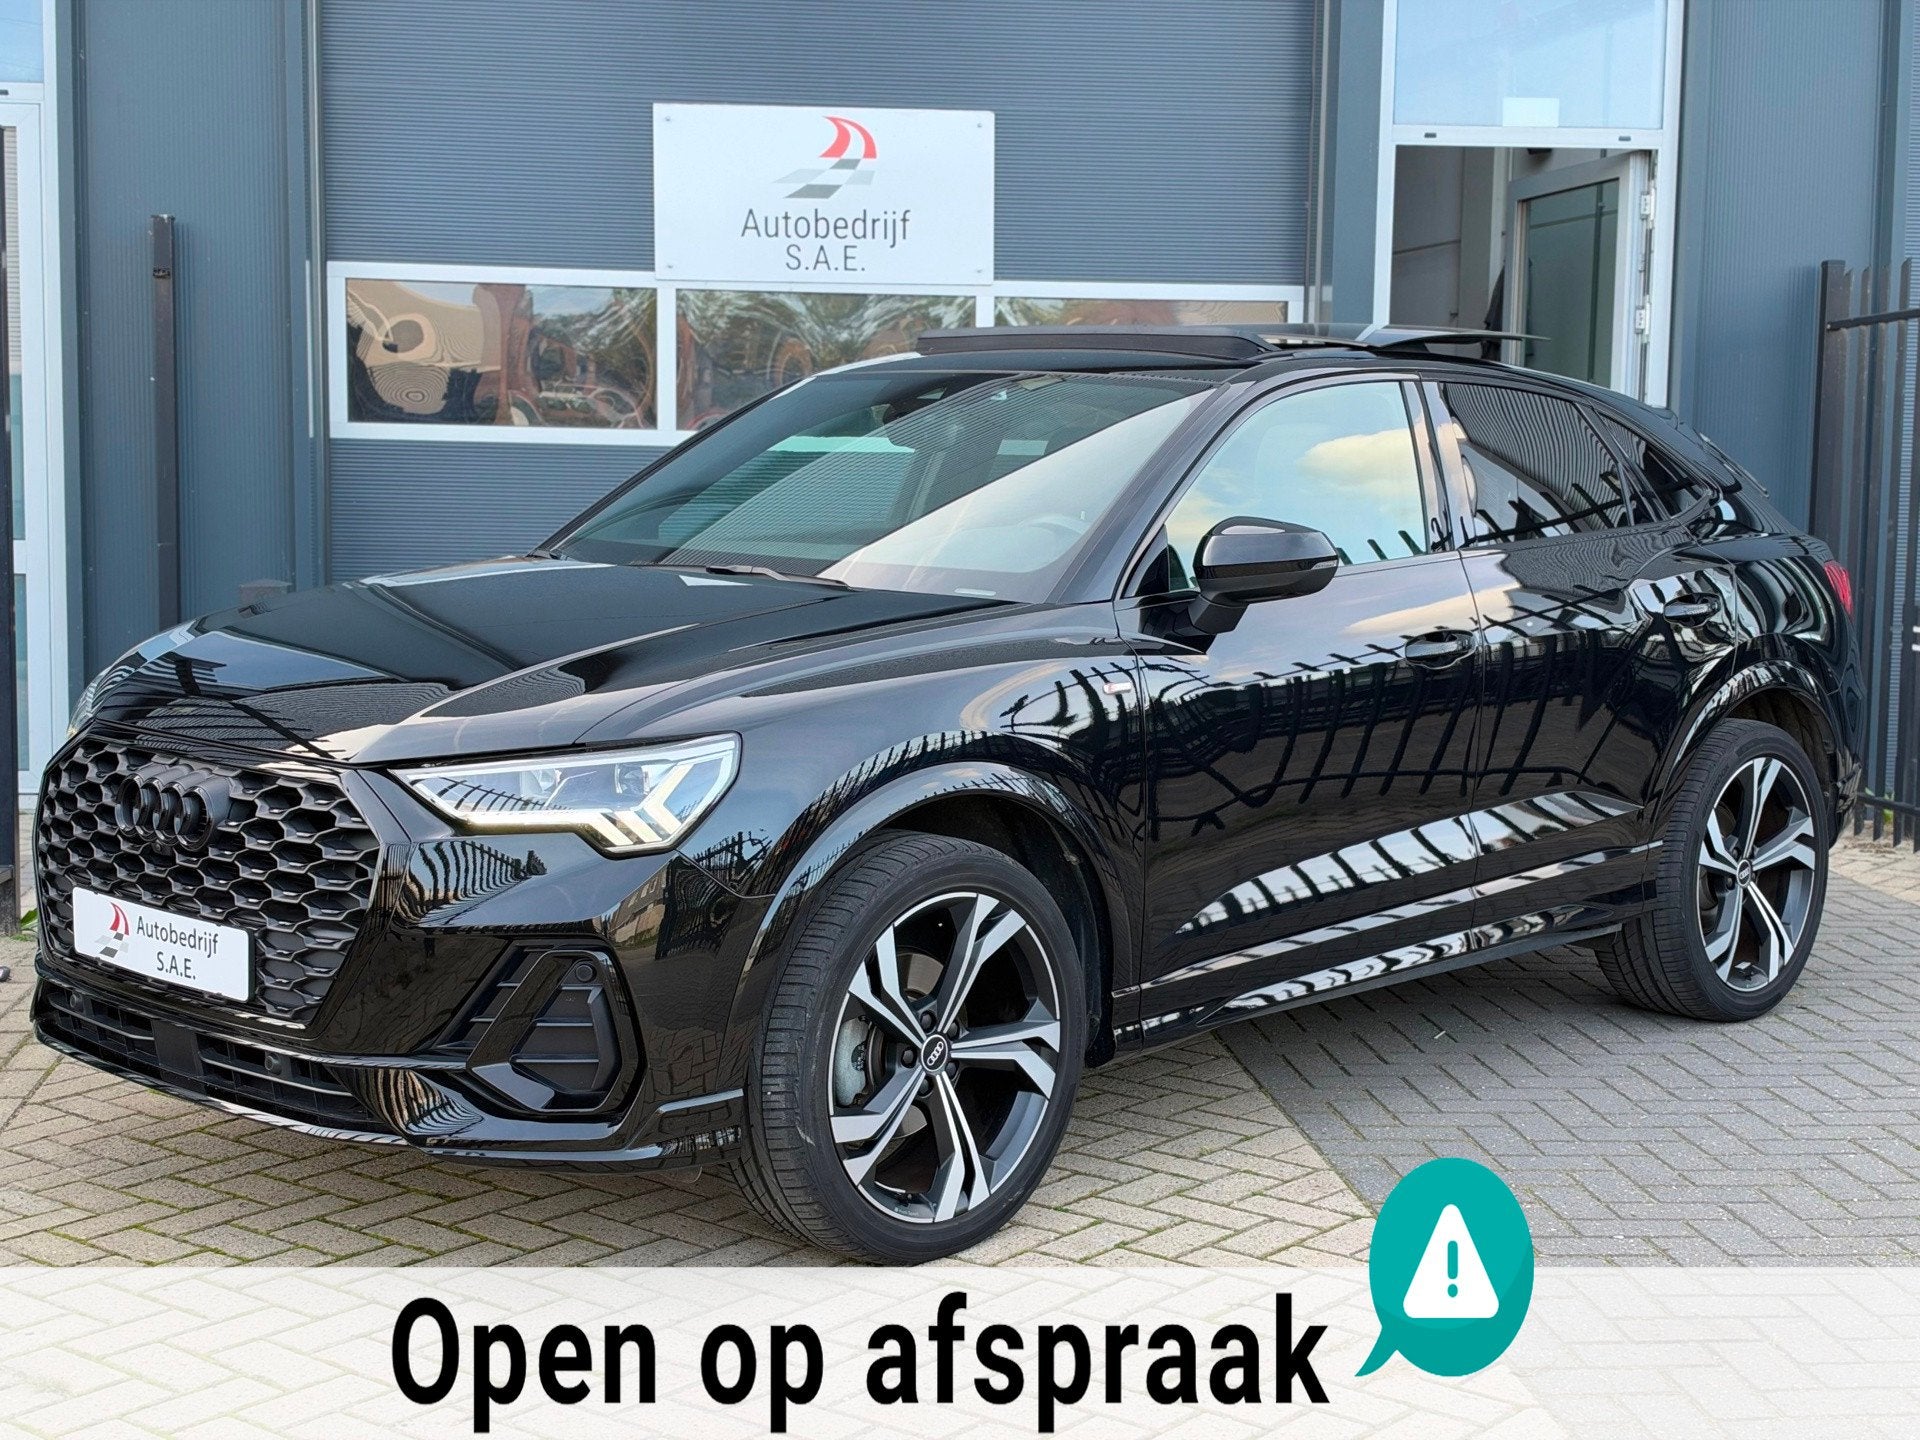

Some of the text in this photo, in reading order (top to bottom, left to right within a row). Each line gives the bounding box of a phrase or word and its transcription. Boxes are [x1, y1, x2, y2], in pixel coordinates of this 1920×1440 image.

[741, 208, 911, 248] Autobedrijf
[785, 243, 866, 272] S.A.E.
[136, 915, 219, 959] Autobedrijf
[156, 951, 197, 980] S.A.E.
